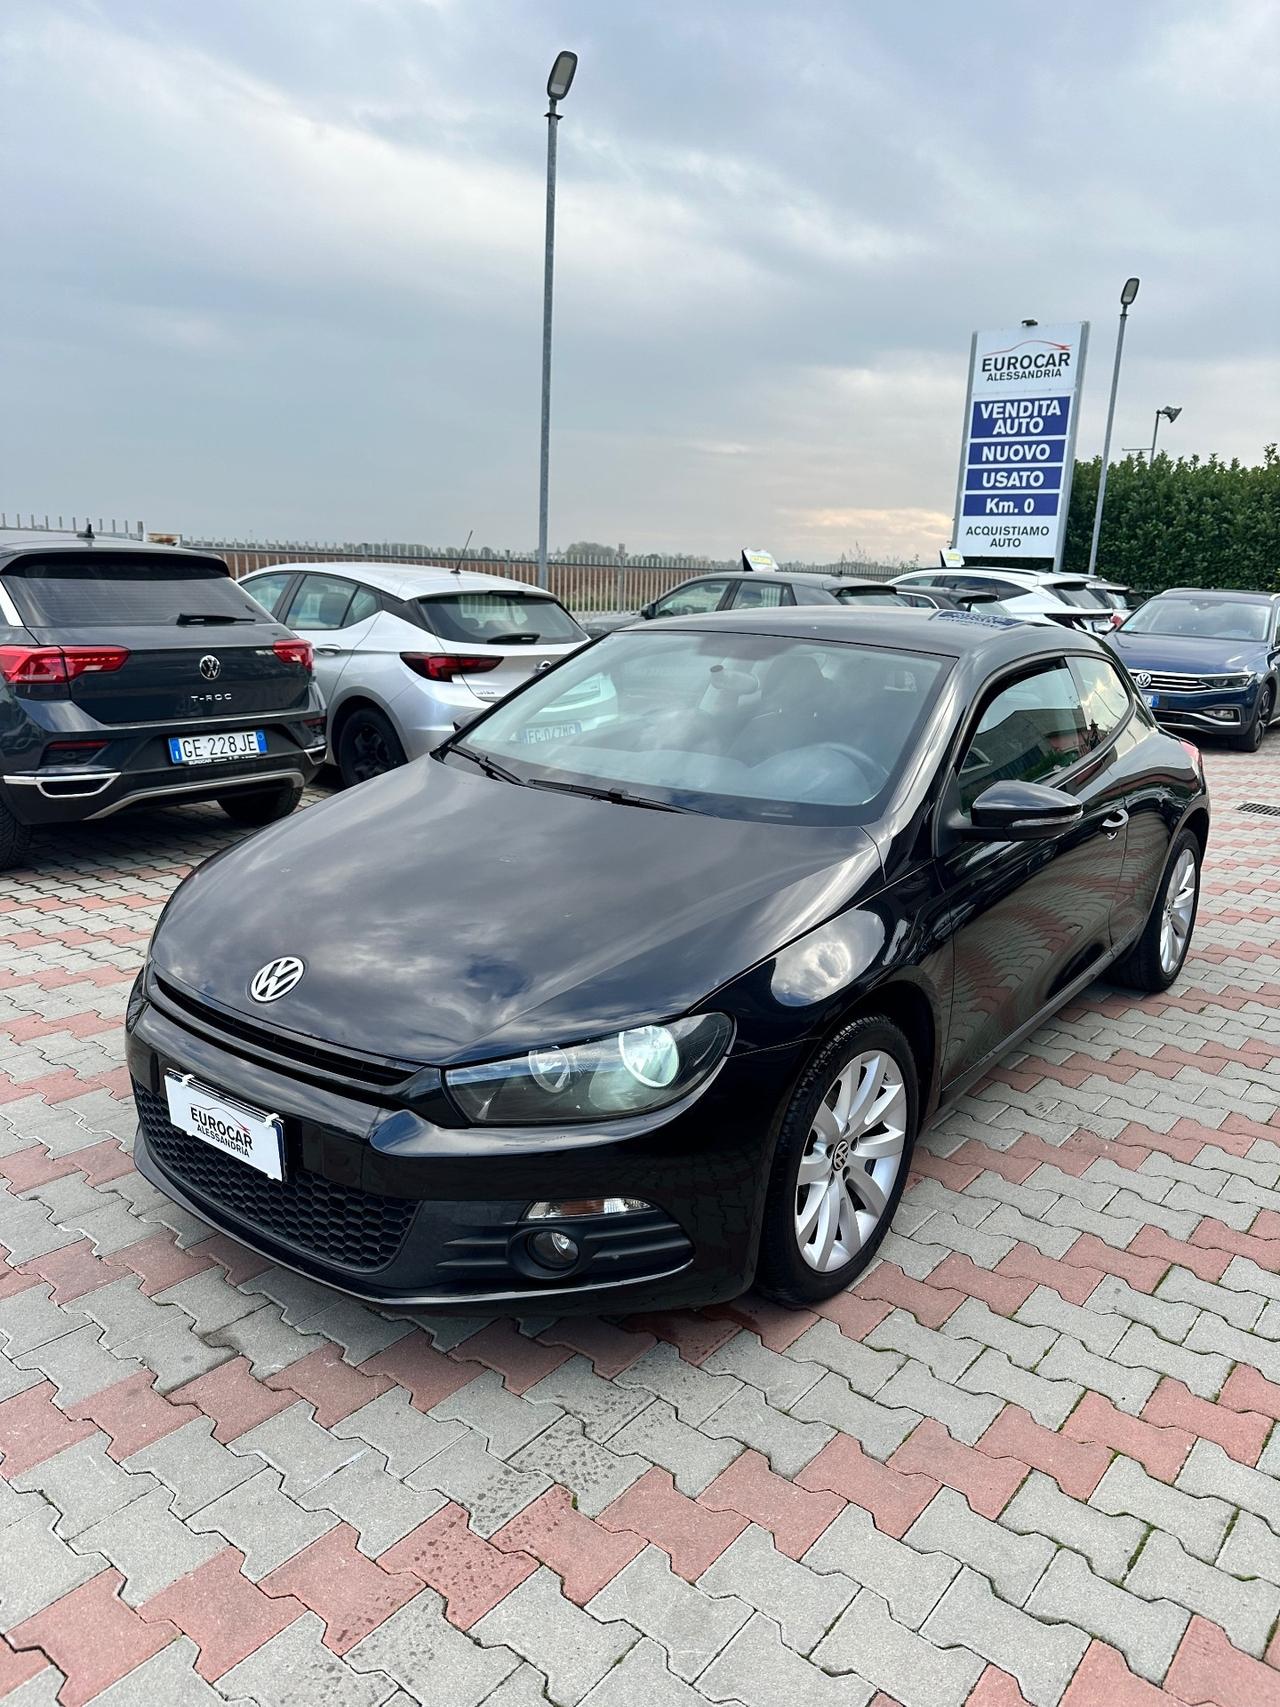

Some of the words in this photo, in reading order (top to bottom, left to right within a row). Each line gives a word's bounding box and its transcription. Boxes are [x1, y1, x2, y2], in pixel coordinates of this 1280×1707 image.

[981, 352, 1071, 373] EUROCAR
[986, 368, 1062, 382] ALESSANDRIA
[980, 399, 1061, 419] VENDITA
[992, 417, 1044, 435] AUTO
[981, 444, 1051, 462] NUOVO
[982, 470, 1045, 488] USATO
[985, 498, 1019, 514] Km.
[1023, 498, 1035, 513] 0
[965, 525, 1050, 536] ACQUISTIAMO
[990, 537, 1022, 548] AUTO
[190, 693, 232, 702] T-ROC
[190, 1106, 253, 1151] EUROCAR
[196, 1123, 250, 1158] ALESSANDRIA
